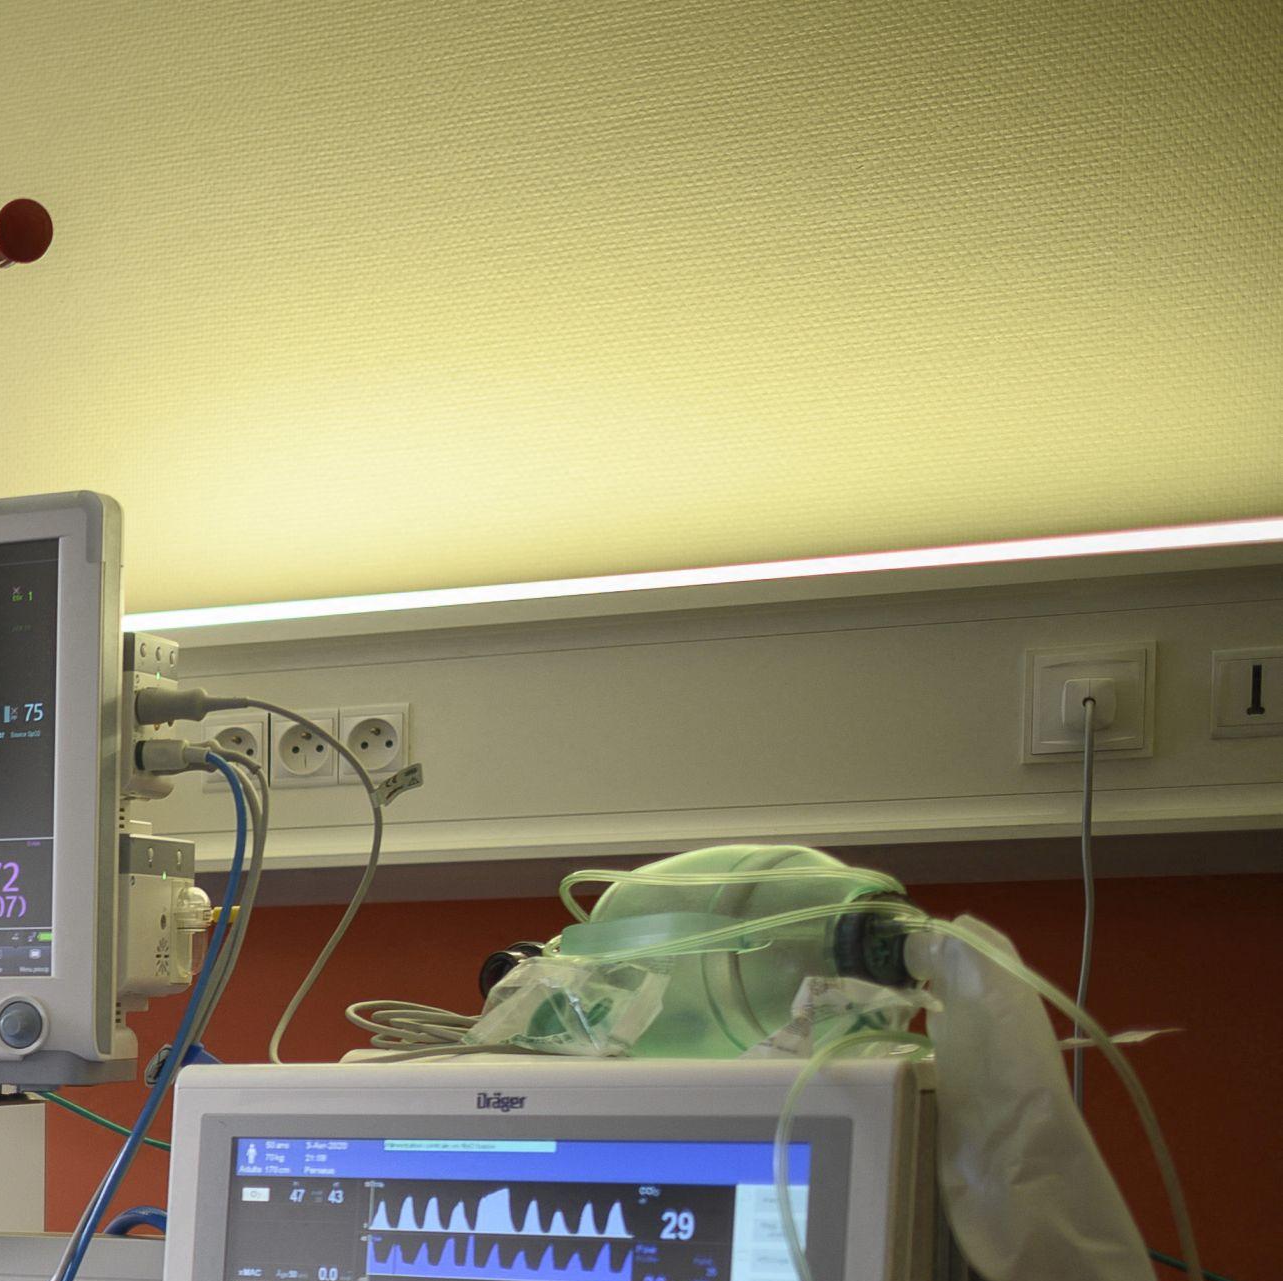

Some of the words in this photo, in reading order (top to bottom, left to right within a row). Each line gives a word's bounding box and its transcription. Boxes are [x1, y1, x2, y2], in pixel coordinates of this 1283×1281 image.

[24, 703, 44, 722] 75
[477, 1093, 526, 1112] Dräger
[289, 1189, 305, 1203] 47
[327, 1189, 344, 1204] 43
[660, 1211, 695, 1240] 29
[318, 1267, 338, 1281] 0.0
